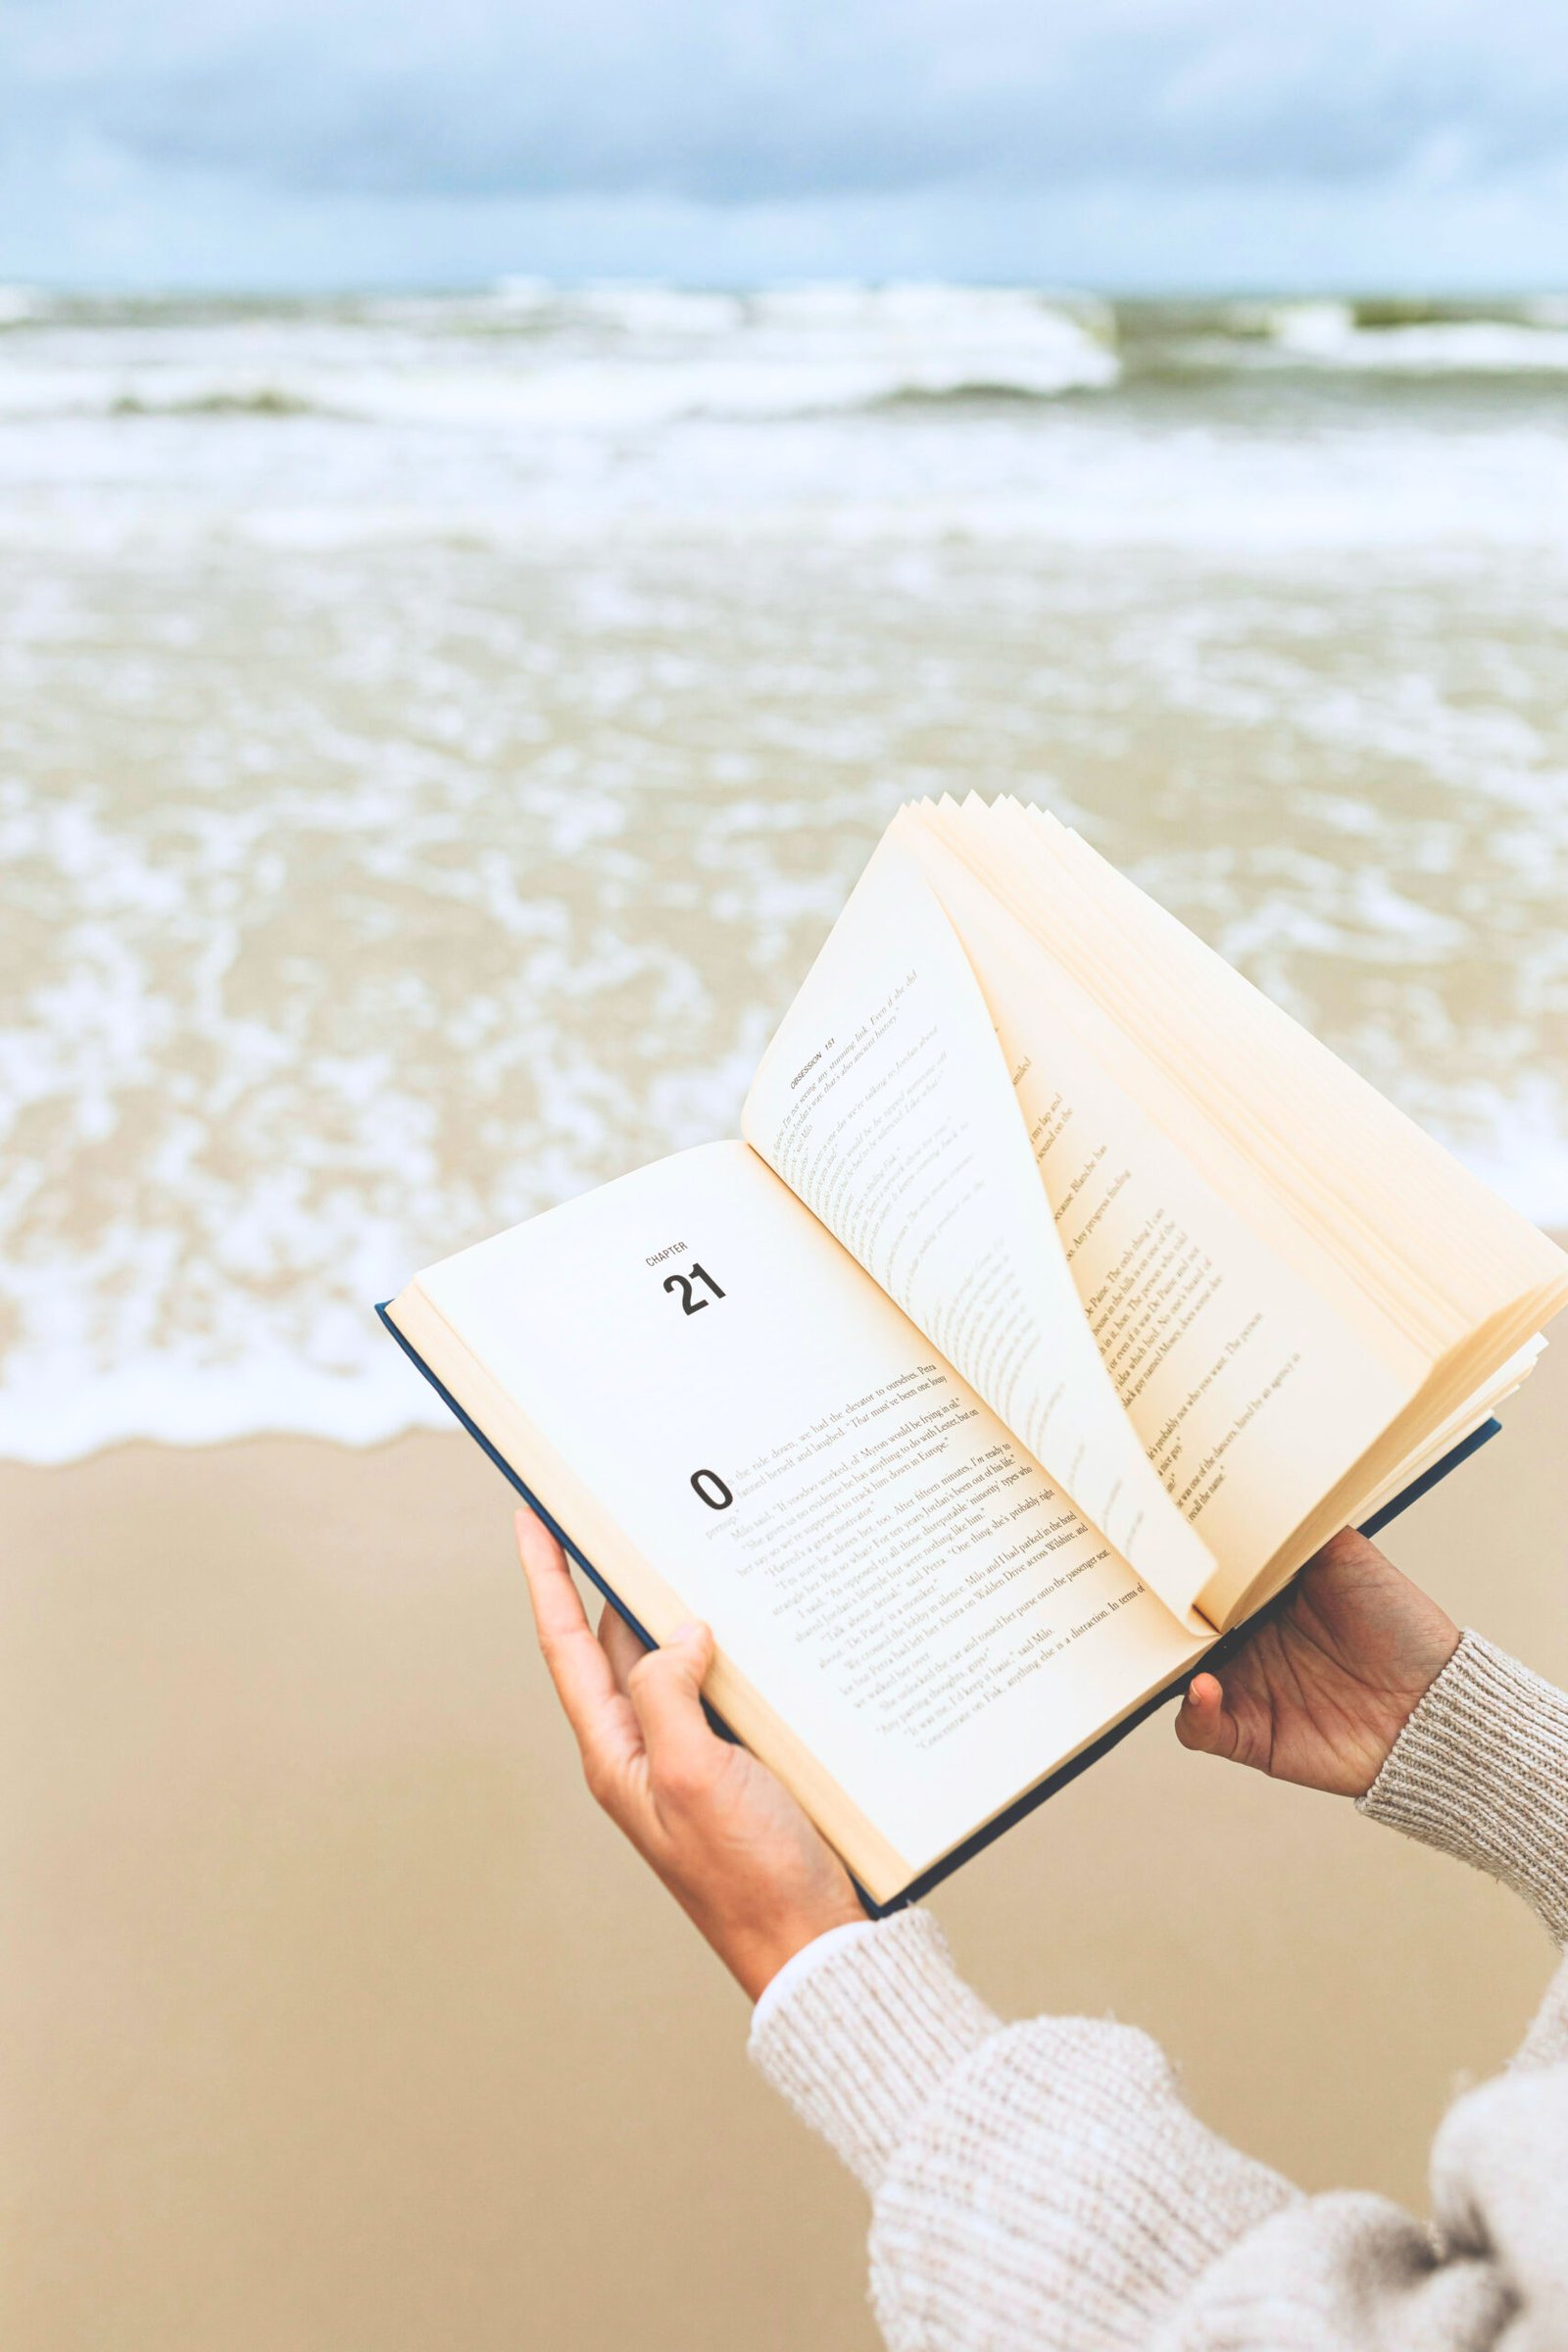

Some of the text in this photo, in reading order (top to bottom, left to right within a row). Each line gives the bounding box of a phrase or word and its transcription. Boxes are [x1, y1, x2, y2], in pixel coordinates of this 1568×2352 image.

[791, 1037, 835, 1090] OBSESSION 151
[646, 1242, 688, 1267] CHAPTER
[663, 1262, 726, 1315] 21
[809, 1418, 829, 1433] had
[829, 1412, 844, 1423] the
[845, 1394, 874, 1413] elevator
[916, 1364, 937, 1375] Petra
[896, 1389, 917, 1400] been
[916, 1382, 930, 1392] one
[887, 1423, 911, 1443] would
[907, 1420, 922, 1429] be
[918, 1409, 944, 1424] frying
[868, 1450, 903, 1474] anything
[908, 1439, 920, 1448] do
[919, 1428, 937, 1442] with
[869, 1478, 889, 1491] him
[889, 1463, 911, 1480] down
[914, 1483, 940, 1500] fifteen
[984, 1445, 1004, 1459] ready
[951, 1482, 973, 1495] been
[971, 1474, 985, 1485] out
[984, 1466, 993, 1477] of
[989, 1463, 1004, 1473] his
[1001, 1473, 1019, 1487] types
[950, 1523, 967, 1536] like
[970, 1528, 993, 1544] thing
[1008, 1496, 1040, 1520] probably
[1039, 1489, 1054, 1500] right
[1076, 1522, 1088, 1535] and
[985, 1558, 1001, 1574] and
[1002, 1544, 1019, 1560] had
[1018, 1529, 1044, 1553] parked
[1049, 1521, 1062, 1531] the
[1057, 1510, 1077, 1525] hotel
[1015, 1597, 1037, 1617] purse
[1037, 1586, 1054, 1599] onto
[1053, 1577, 1066, 1588] the
[1065, 1556, 1097, 1582] passenger
[1106, 1602, 1119, 1611] In
[1118, 1590, 1138, 1604] terms
